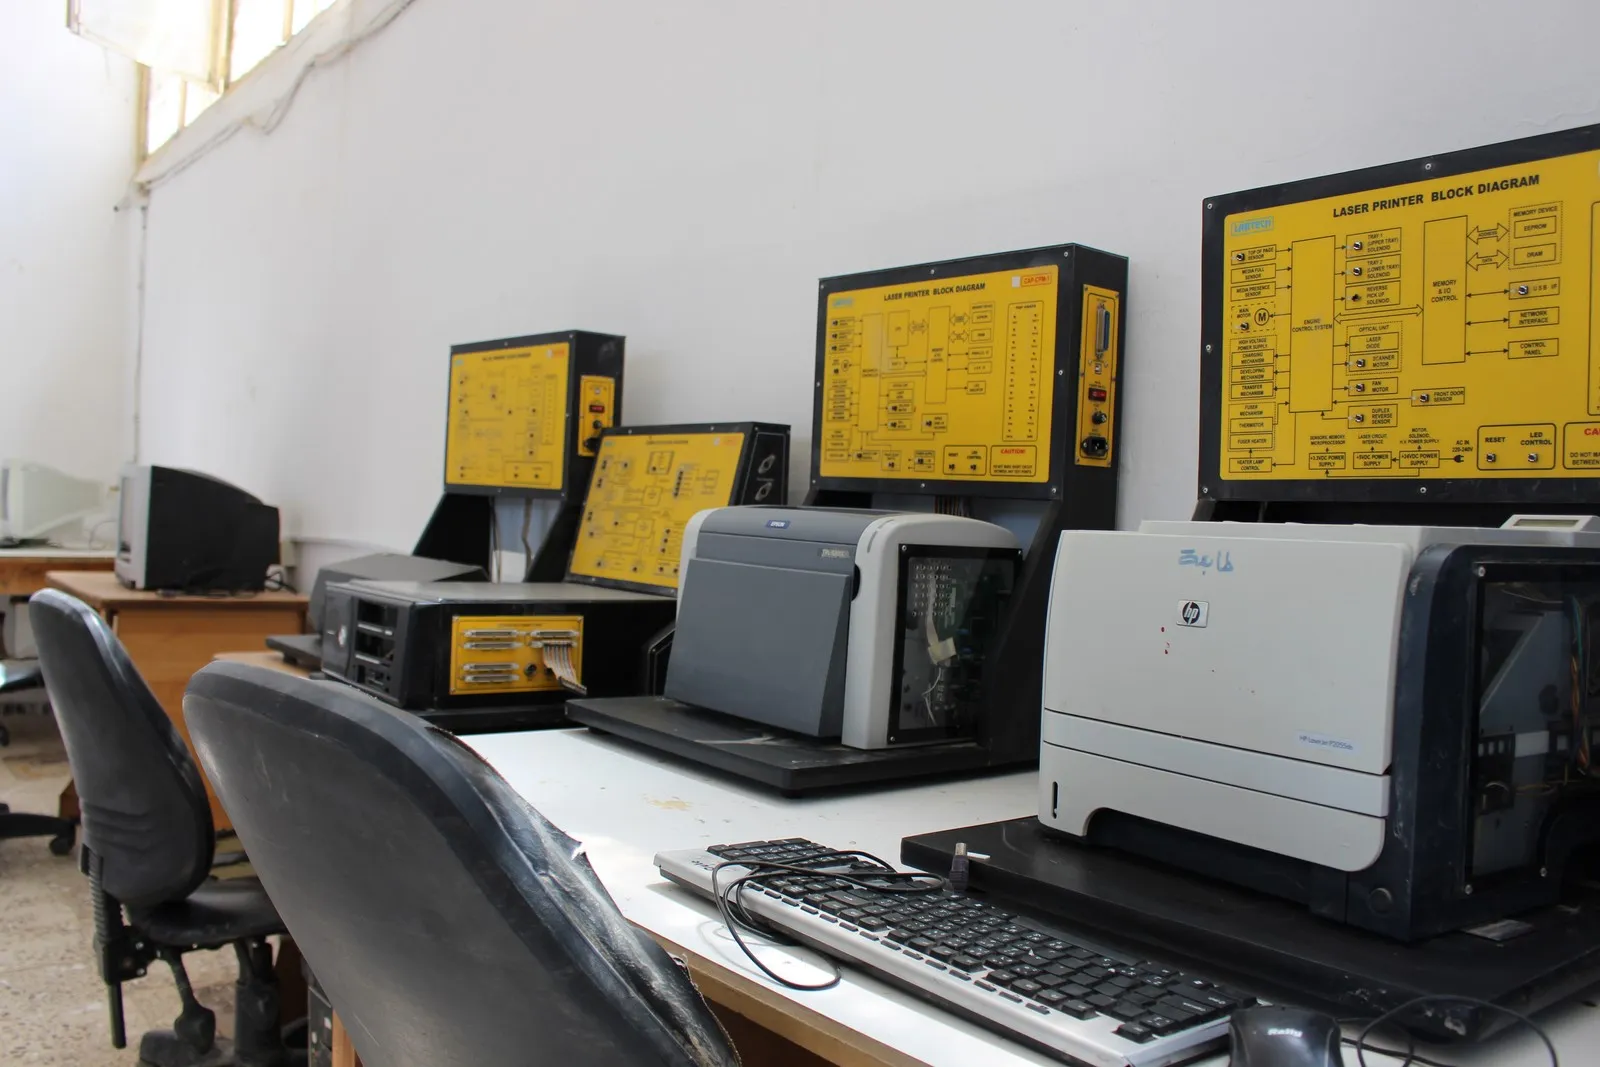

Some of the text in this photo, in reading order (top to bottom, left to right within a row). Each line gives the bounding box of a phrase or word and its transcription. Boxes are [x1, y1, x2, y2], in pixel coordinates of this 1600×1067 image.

[1333, 174, 1540, 218] LASER PRINTER BLOCK DIAGRAM
[1513, 205, 1558, 217] MEMORY DEVICE
[1524, 223, 1547, 231] EEPROM
[1432, 279, 1457, 287] MEMORY
[884, 282, 985, 302] LASER PRINTER BLOCK DIAGRAM
[1431, 295, 1458, 303] CONTROL
[1258, 312, 1266, 322] M
[1519, 317, 1548, 325] INTERFACE
[1520, 341, 1546, 349] CONTROL
[1183, 601, 1199, 625] hp
